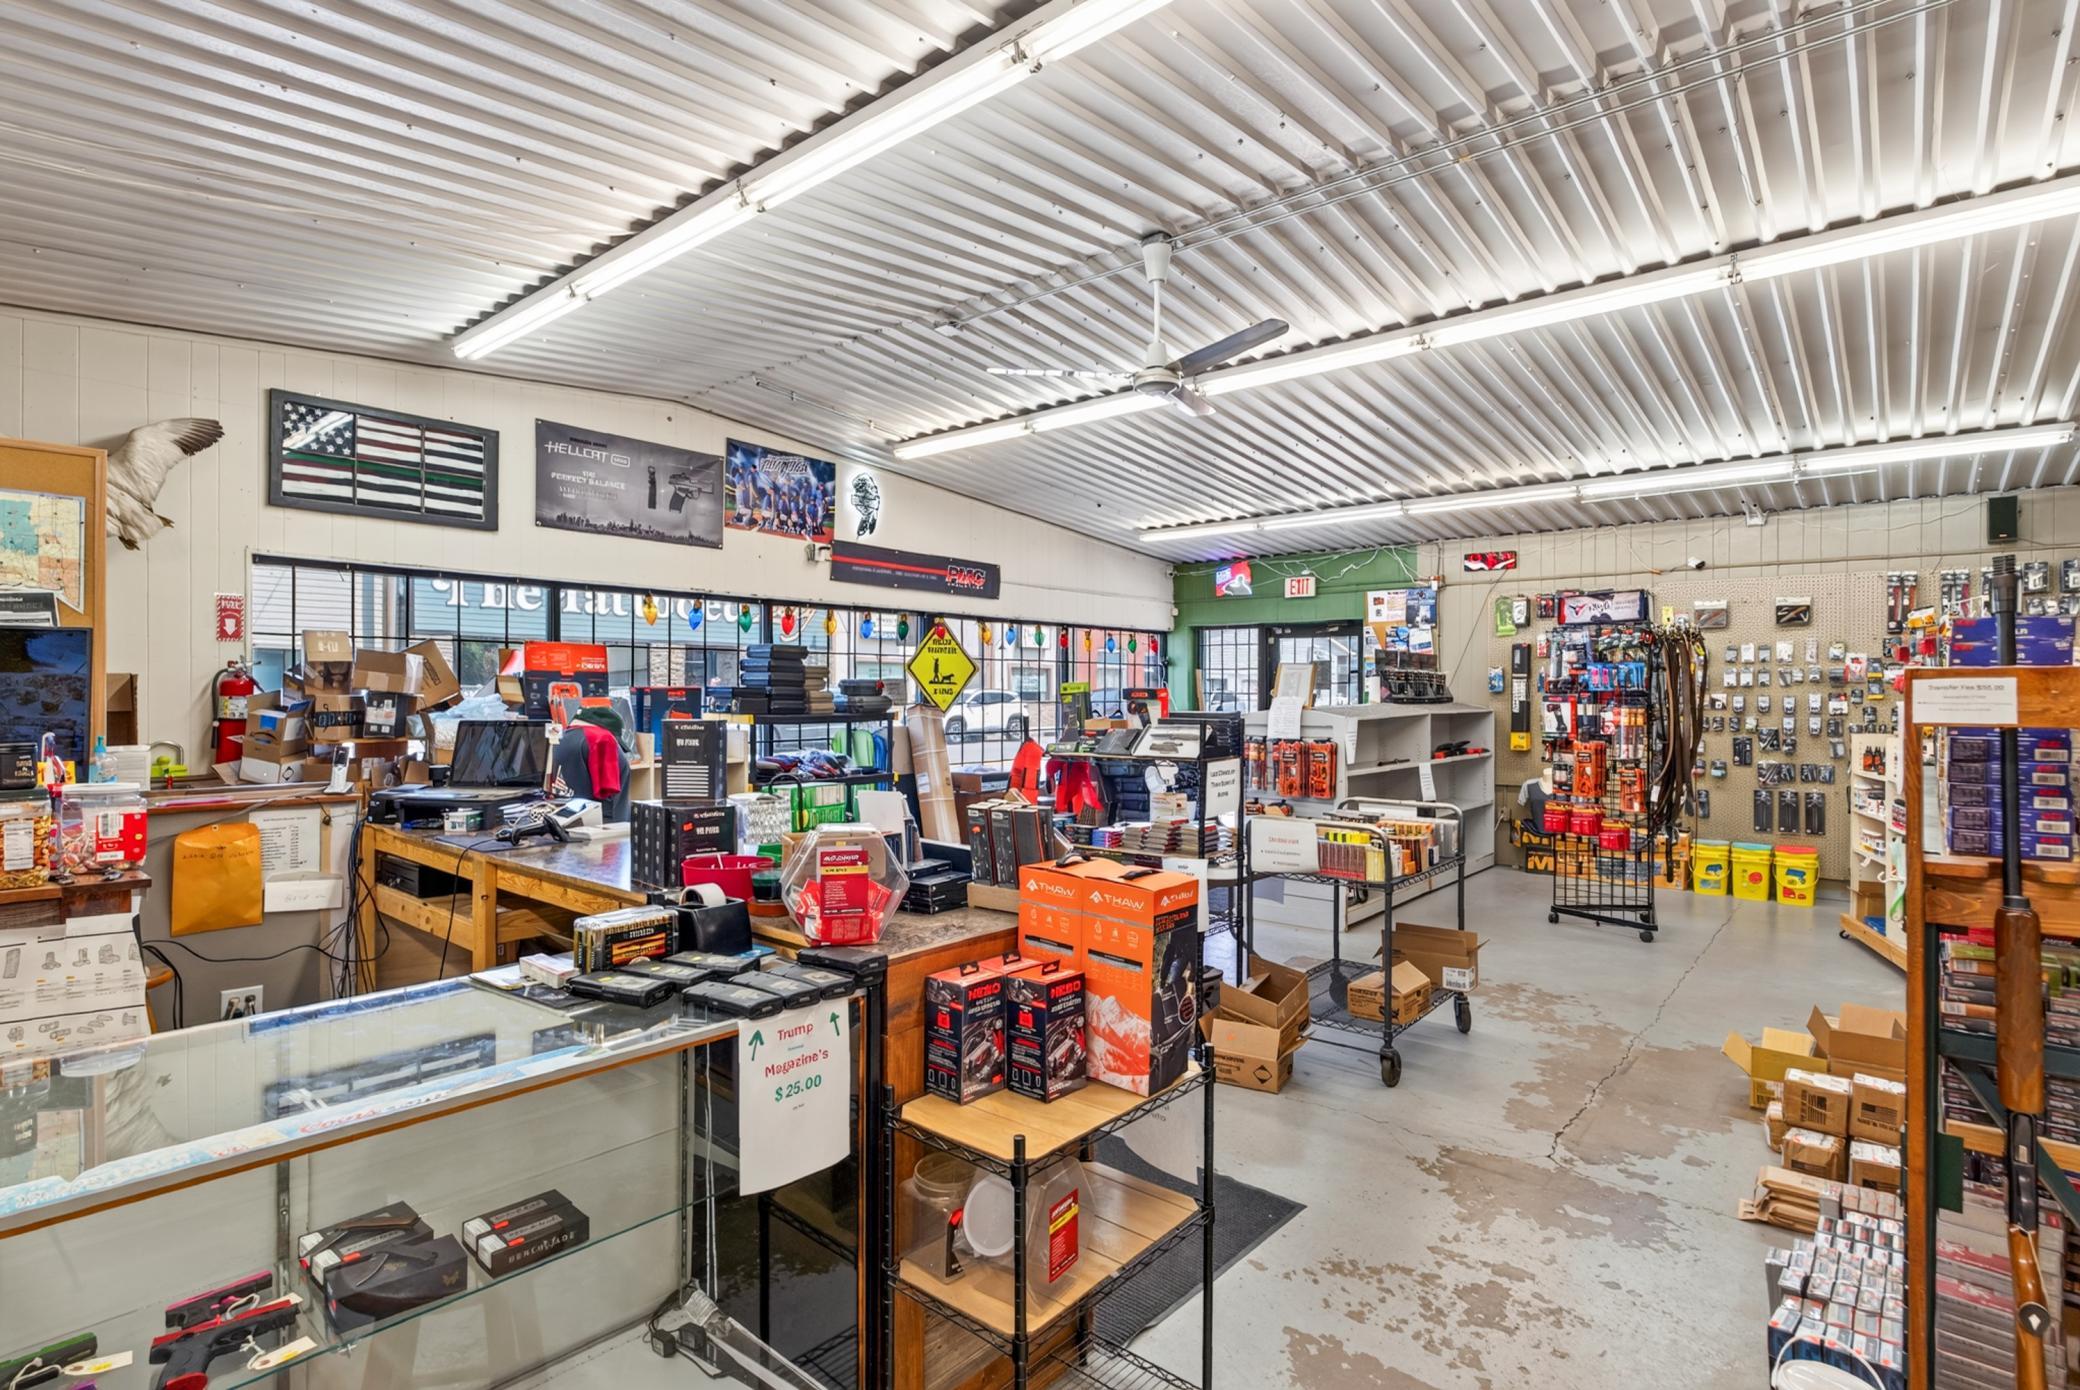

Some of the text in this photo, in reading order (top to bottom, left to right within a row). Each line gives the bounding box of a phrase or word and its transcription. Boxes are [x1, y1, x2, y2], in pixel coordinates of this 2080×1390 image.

[544, 441, 609, 463] HELLCAT
[1290, 578, 1310, 595] EXIT
[1038, 882, 1076, 898] THAW
[1103, 894, 1145, 910] THAW
[777, 1023, 814, 1041] Trump
[765, 1049, 829, 1078] Magazine's
[774, 1074, 822, 1103] $25.00
